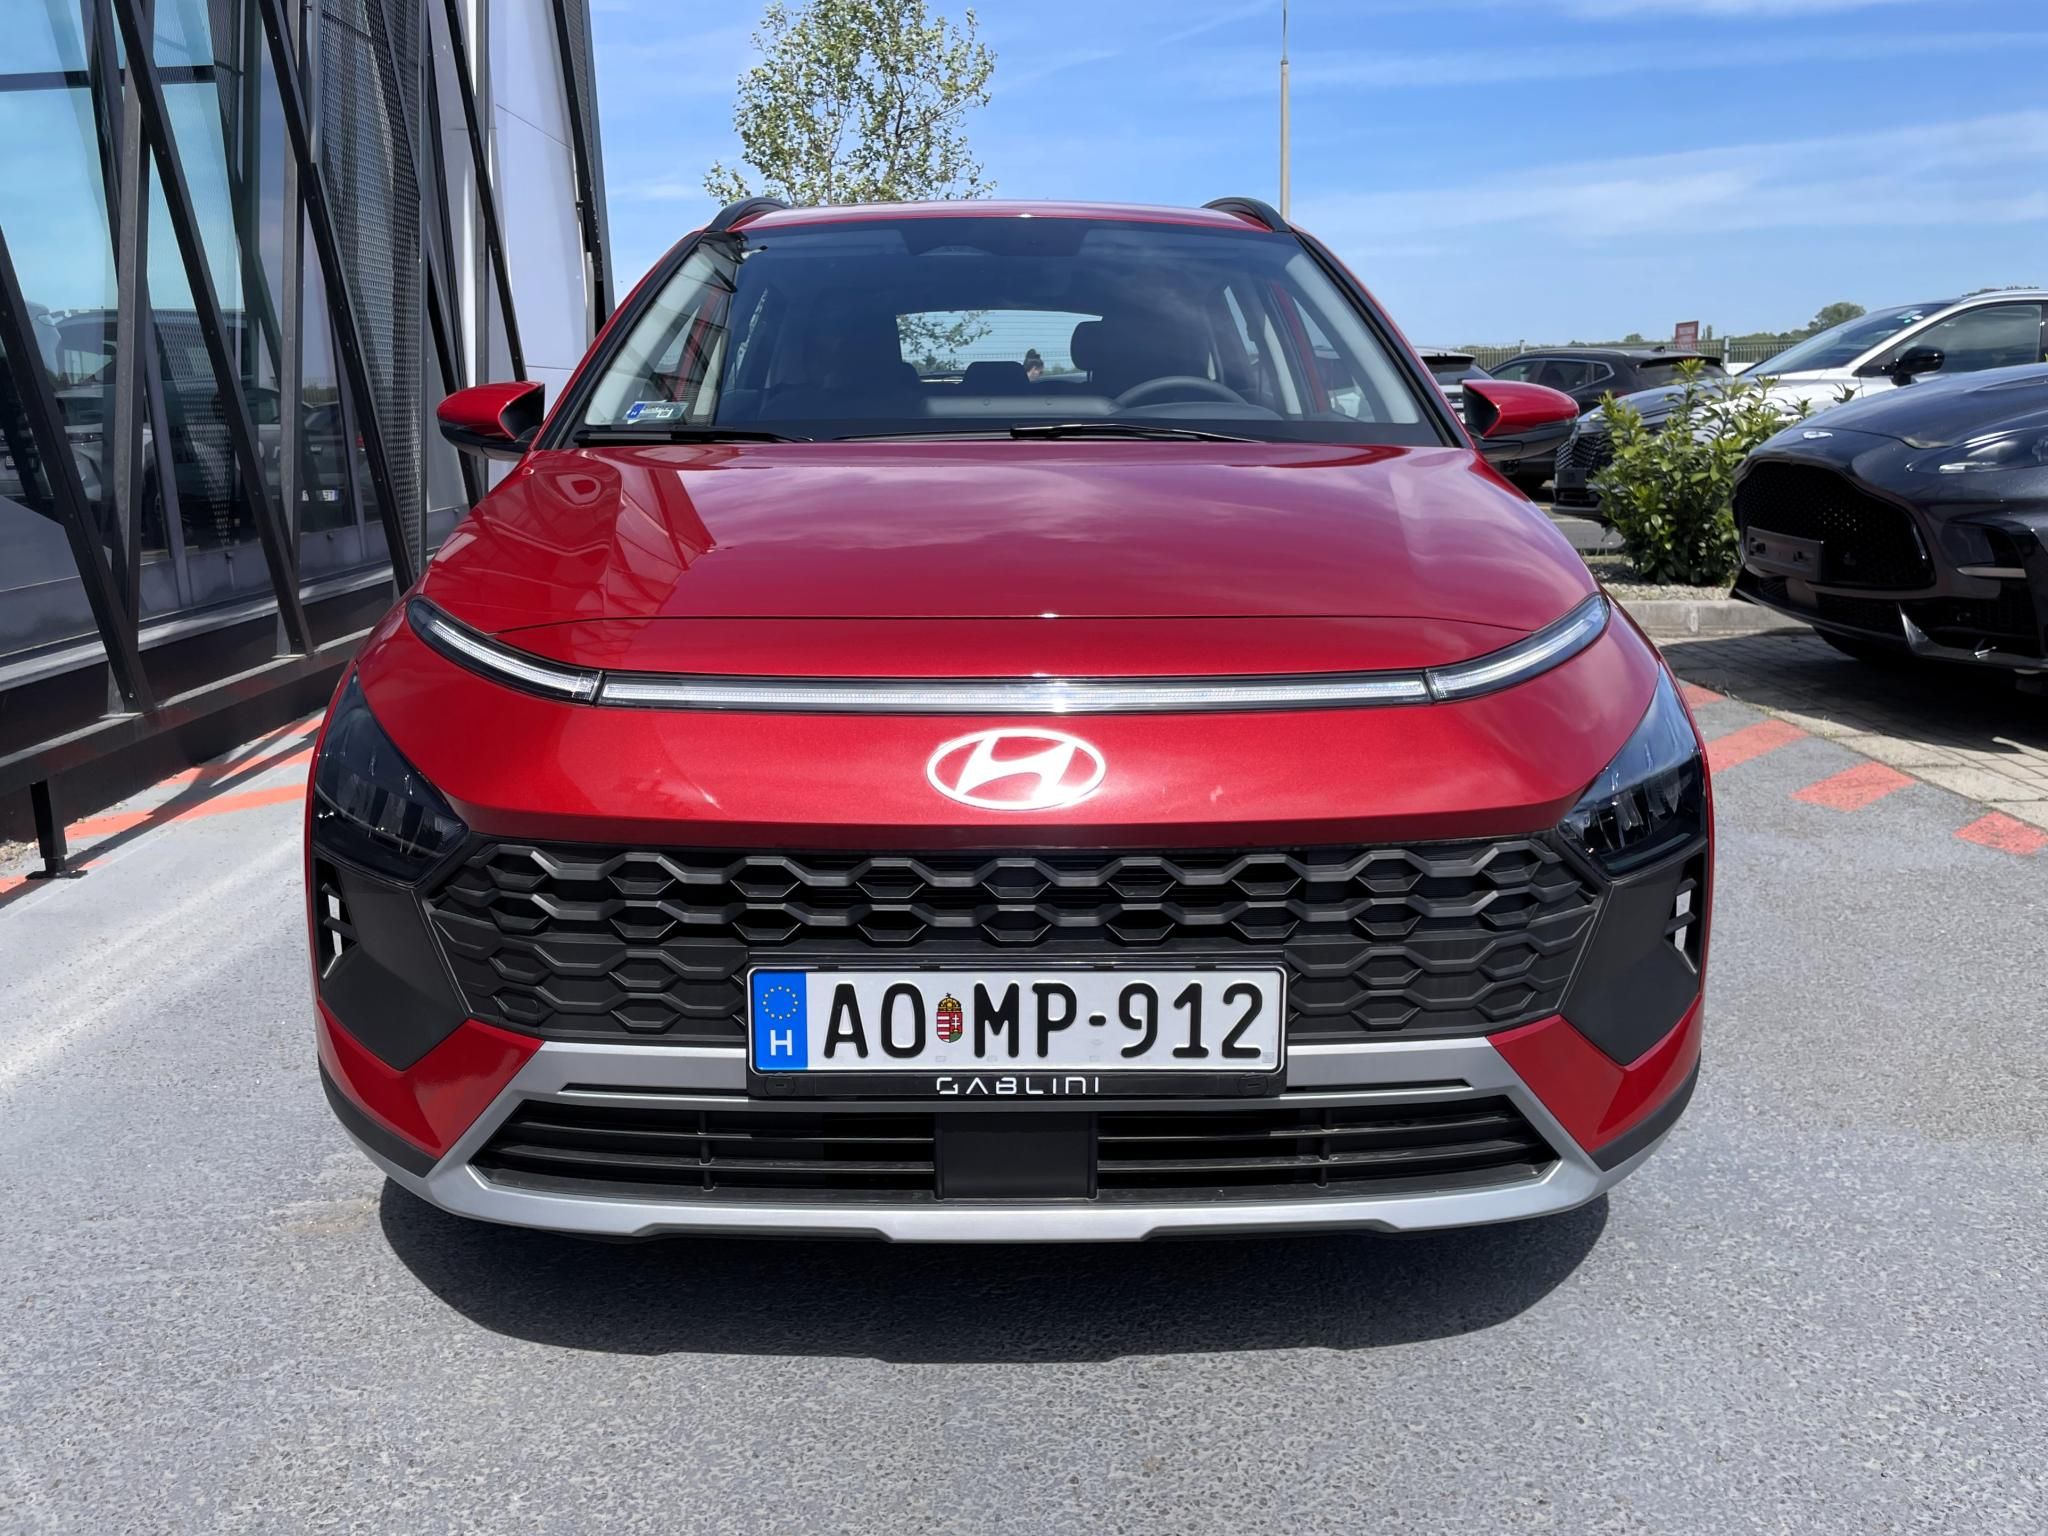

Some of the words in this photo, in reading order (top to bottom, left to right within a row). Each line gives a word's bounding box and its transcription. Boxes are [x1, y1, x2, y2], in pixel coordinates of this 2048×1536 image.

[823, 983, 926, 1059] AO
[973, 982, 1263, 1059] MP-912
[770, 1029, 793, 1056] H
[936, 1076, 1100, 1095] GABLINI
